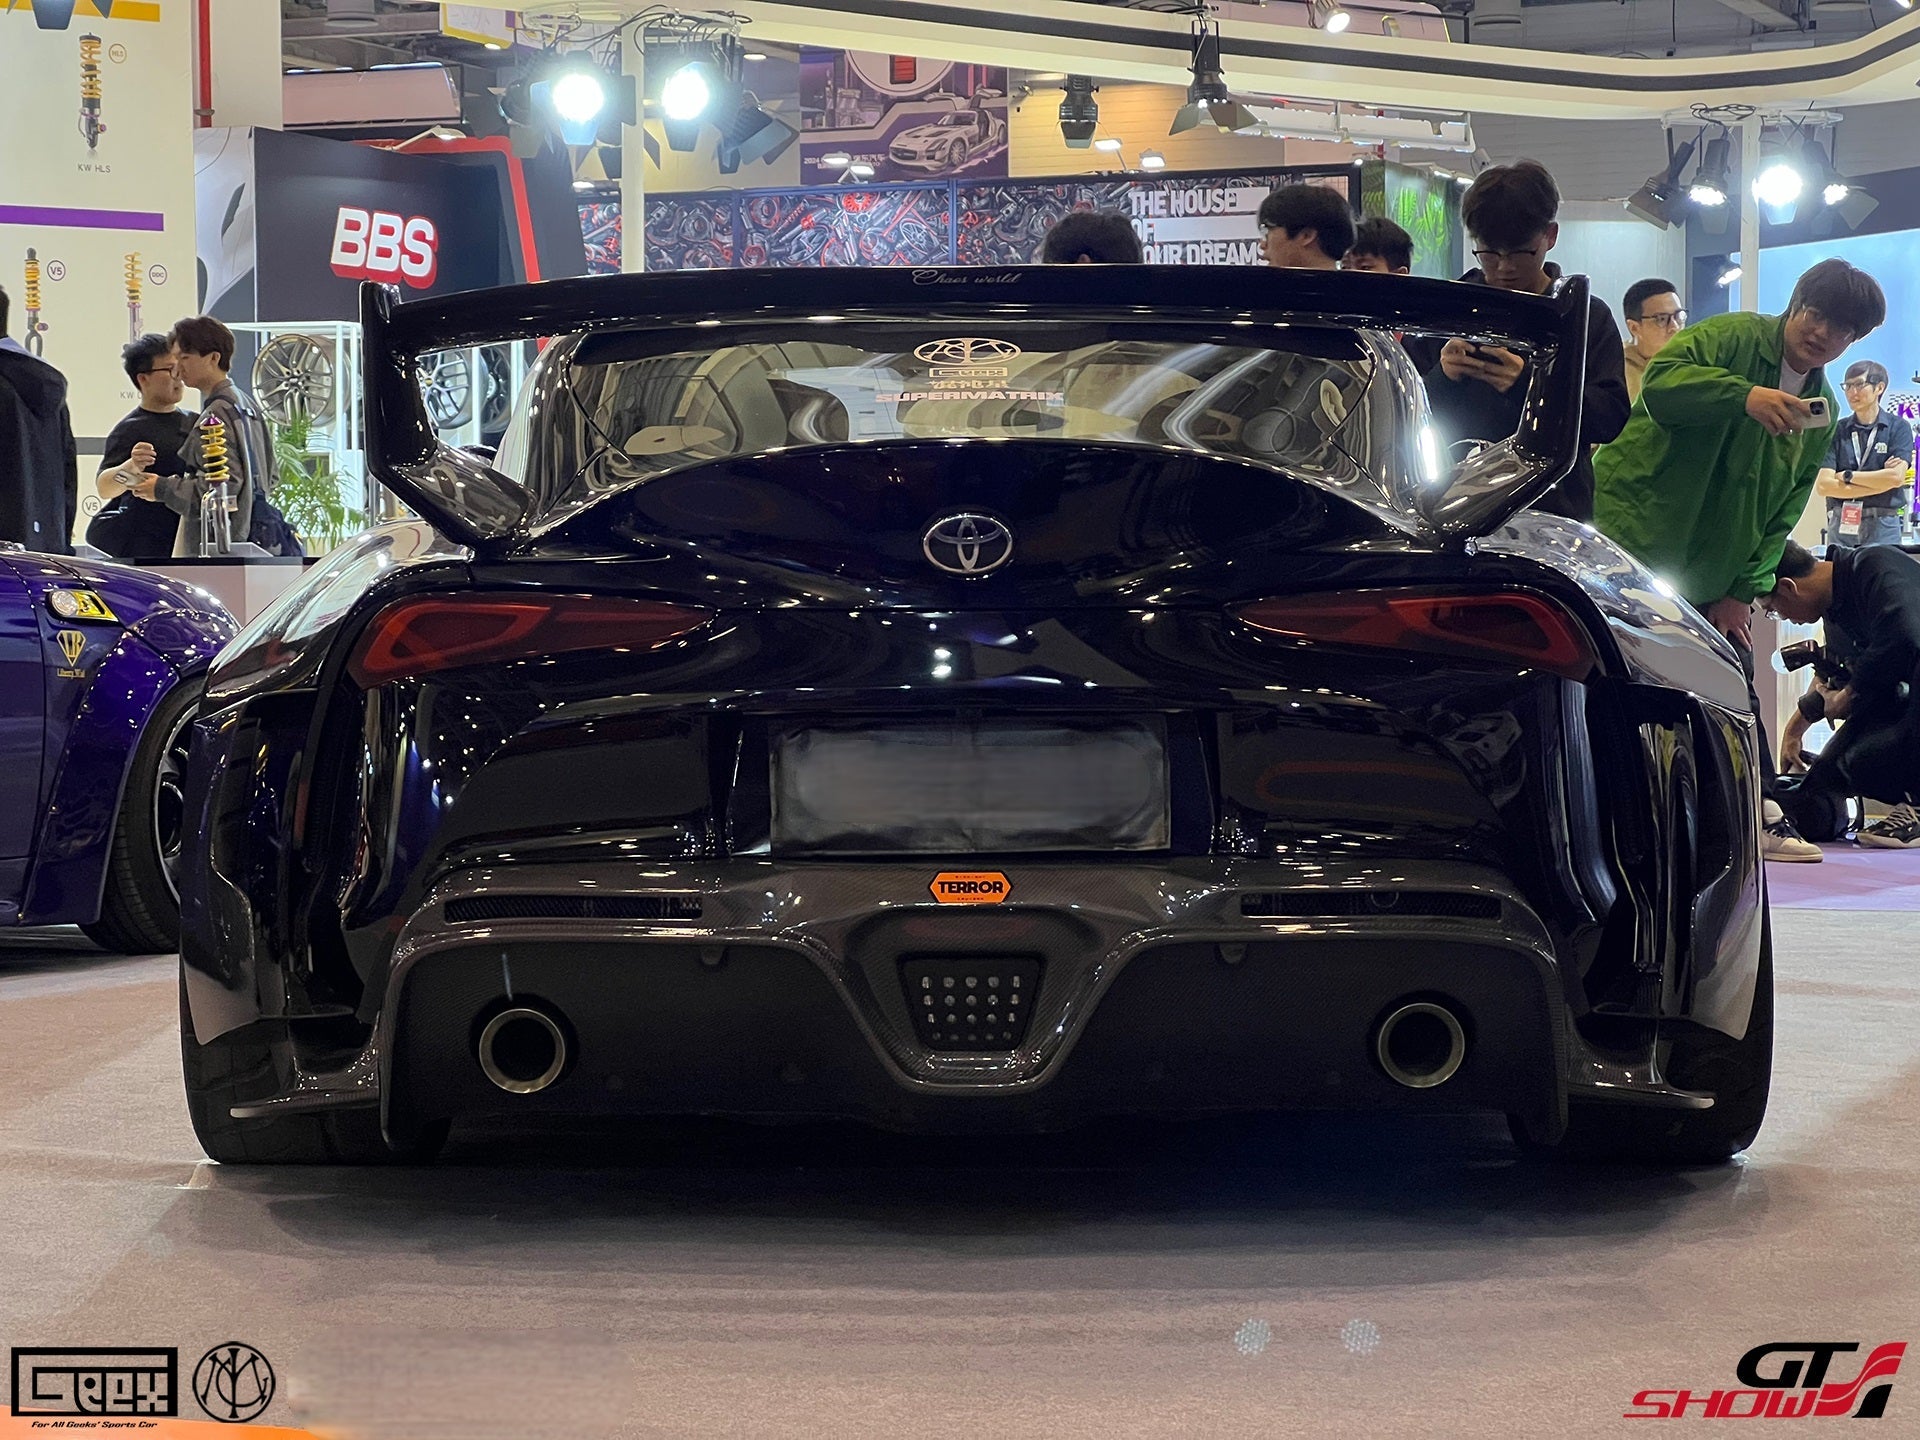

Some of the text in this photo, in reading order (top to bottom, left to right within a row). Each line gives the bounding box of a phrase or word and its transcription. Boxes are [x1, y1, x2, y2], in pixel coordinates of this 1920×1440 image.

[77, 163, 111, 173] KW HLS
[1128, 187, 1238, 217] THE HOUSE
[1131, 217, 1156, 242] OF
[330, 206, 438, 283] BBS
[1143, 242, 1269, 266] OUR DREAMS
[50, 266, 63, 276] V5
[911, 269, 1023, 286] Chaos world
[120, 391, 134, 399] KW
[875, 391, 1065, 402] SUPERMATRIX
[1898, 402, 1920, 419] K
[85, 502, 99, 511] V5
[938, 881, 1004, 894] TERROR
